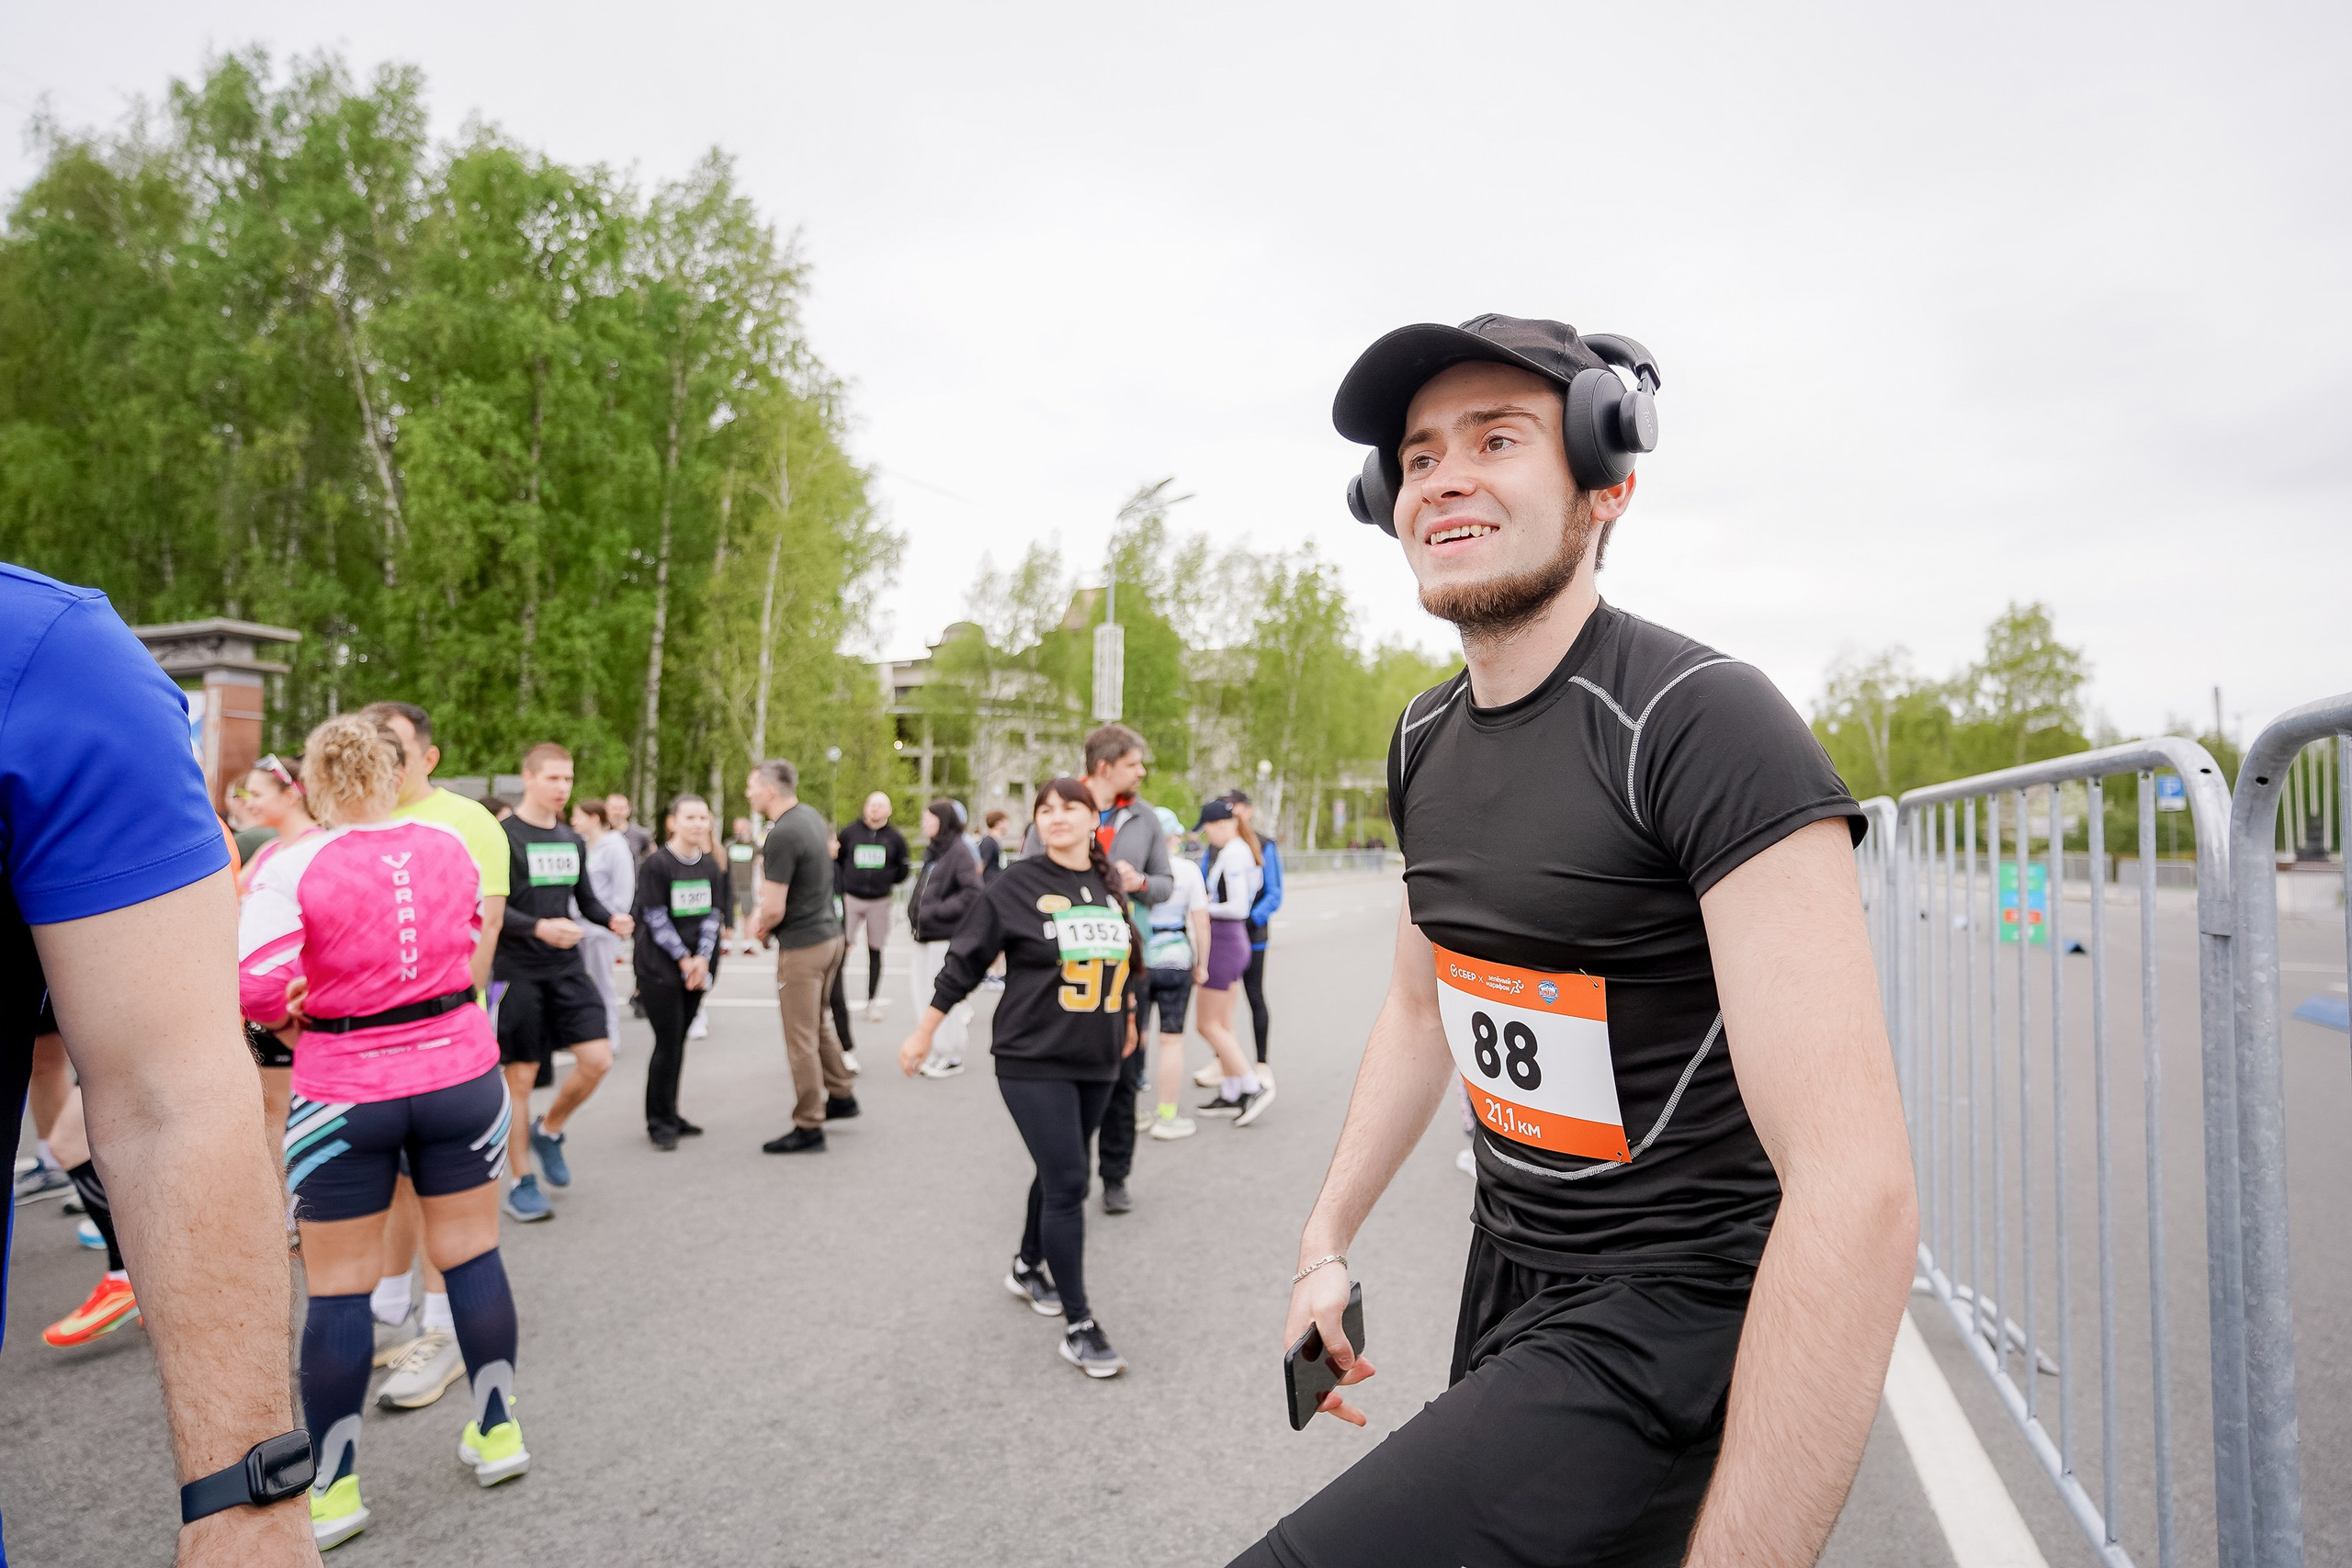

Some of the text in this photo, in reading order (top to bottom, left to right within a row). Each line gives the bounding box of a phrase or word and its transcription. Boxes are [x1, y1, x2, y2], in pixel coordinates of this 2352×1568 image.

[1069, 923, 1122, 942] 1352
[1057, 957, 1131, 1013] 97
[1457, 968, 1476, 982] СБЕР
[1471, 1010, 1543, 1091] 88
[1485, 1098, 1516, 1133] 21,1
